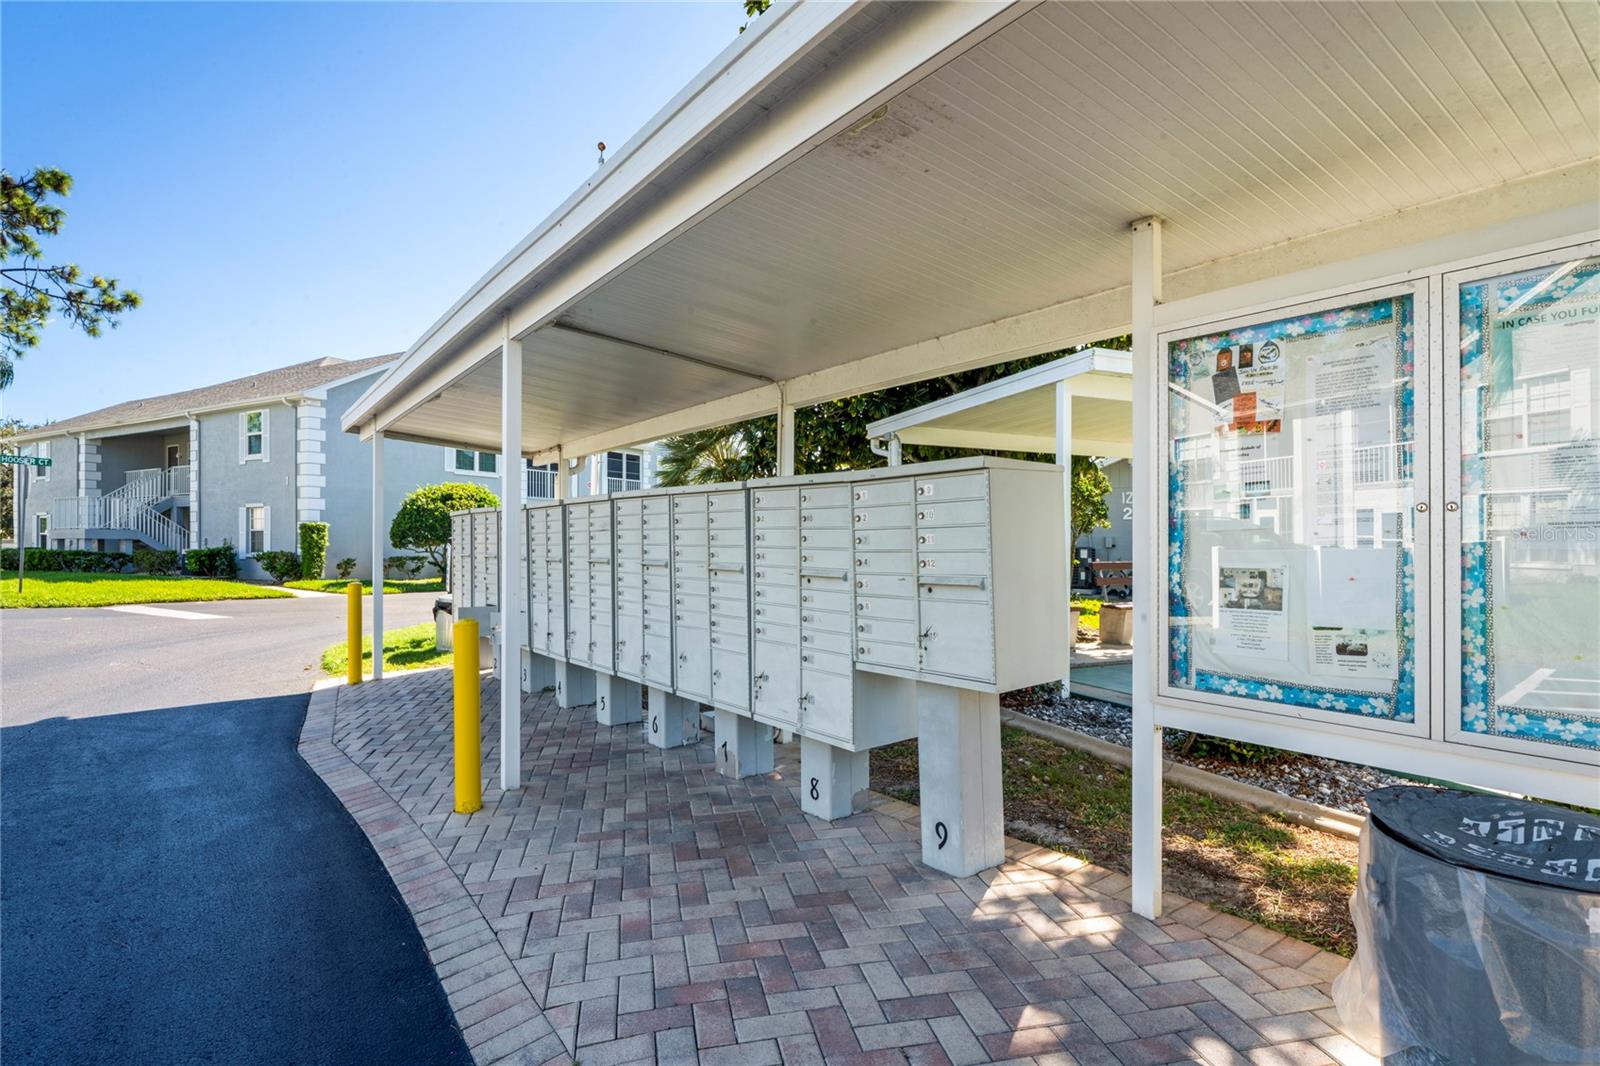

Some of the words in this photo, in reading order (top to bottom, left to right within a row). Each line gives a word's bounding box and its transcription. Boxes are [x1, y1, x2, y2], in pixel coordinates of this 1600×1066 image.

[1502, 320, 1515, 329] IN
[1518, 315, 1546, 326] CASE
[1550, 309, 1577, 320] YOU
[1581, 306, 1600, 316] FU
[2, 456, 35, 465] HOOSIER
[523, 668, 528, 682] 3
[557, 681, 562, 696] 4
[601, 696, 606, 711] 5
[652, 715, 659, 734] 6
[810, 777, 819, 801] 8
[935, 821, 948, 850] 9
